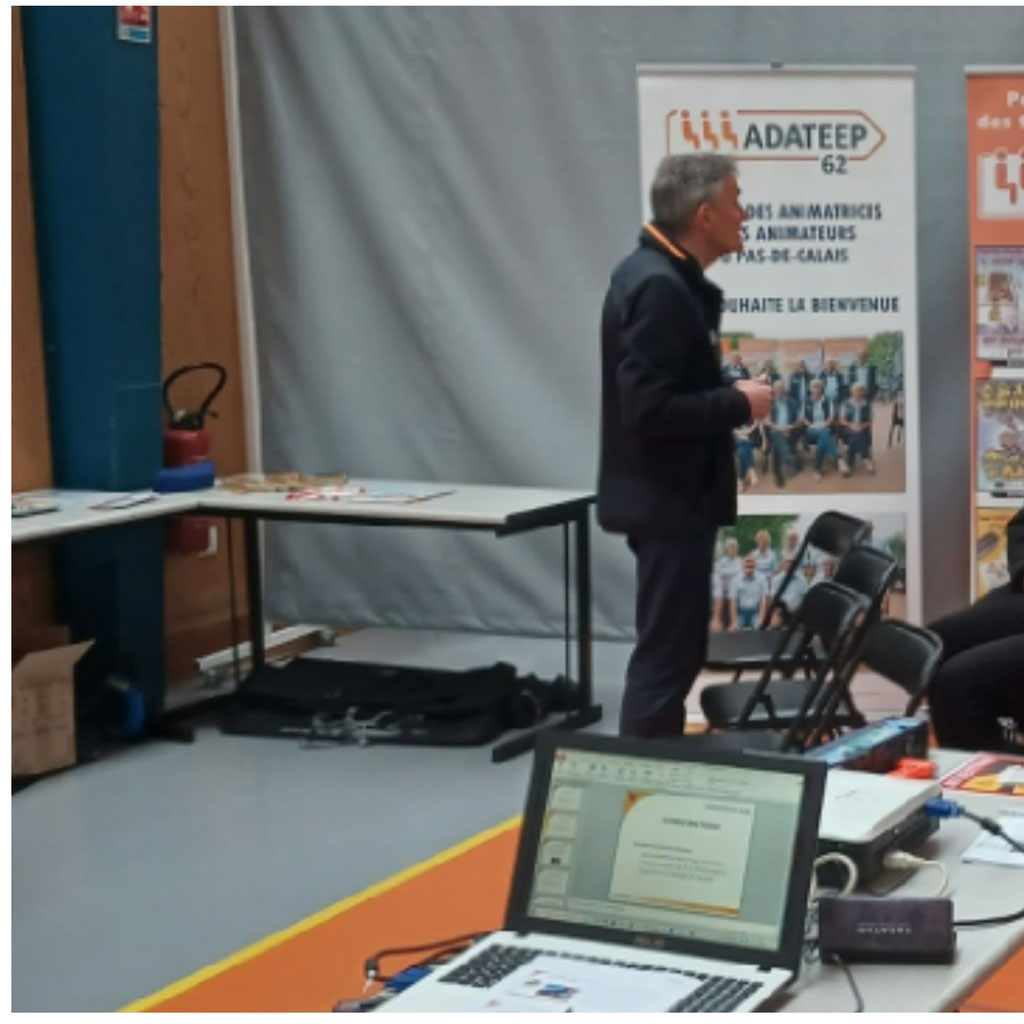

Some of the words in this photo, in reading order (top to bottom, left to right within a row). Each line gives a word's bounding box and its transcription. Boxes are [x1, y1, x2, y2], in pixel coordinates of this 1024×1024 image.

[976, 114, 1011, 130] des
[743, 123, 868, 151] ADATEEP
[821, 154, 848, 175] 62
[778, 203, 882, 220] ANIMATRICES
[756, 226, 856, 241] ANIMATEURS
[736, 248, 849, 264] PAS-DE-CALAIS
[788, 297, 806, 313] LA
[811, 297, 899, 313] BIENVENUE
